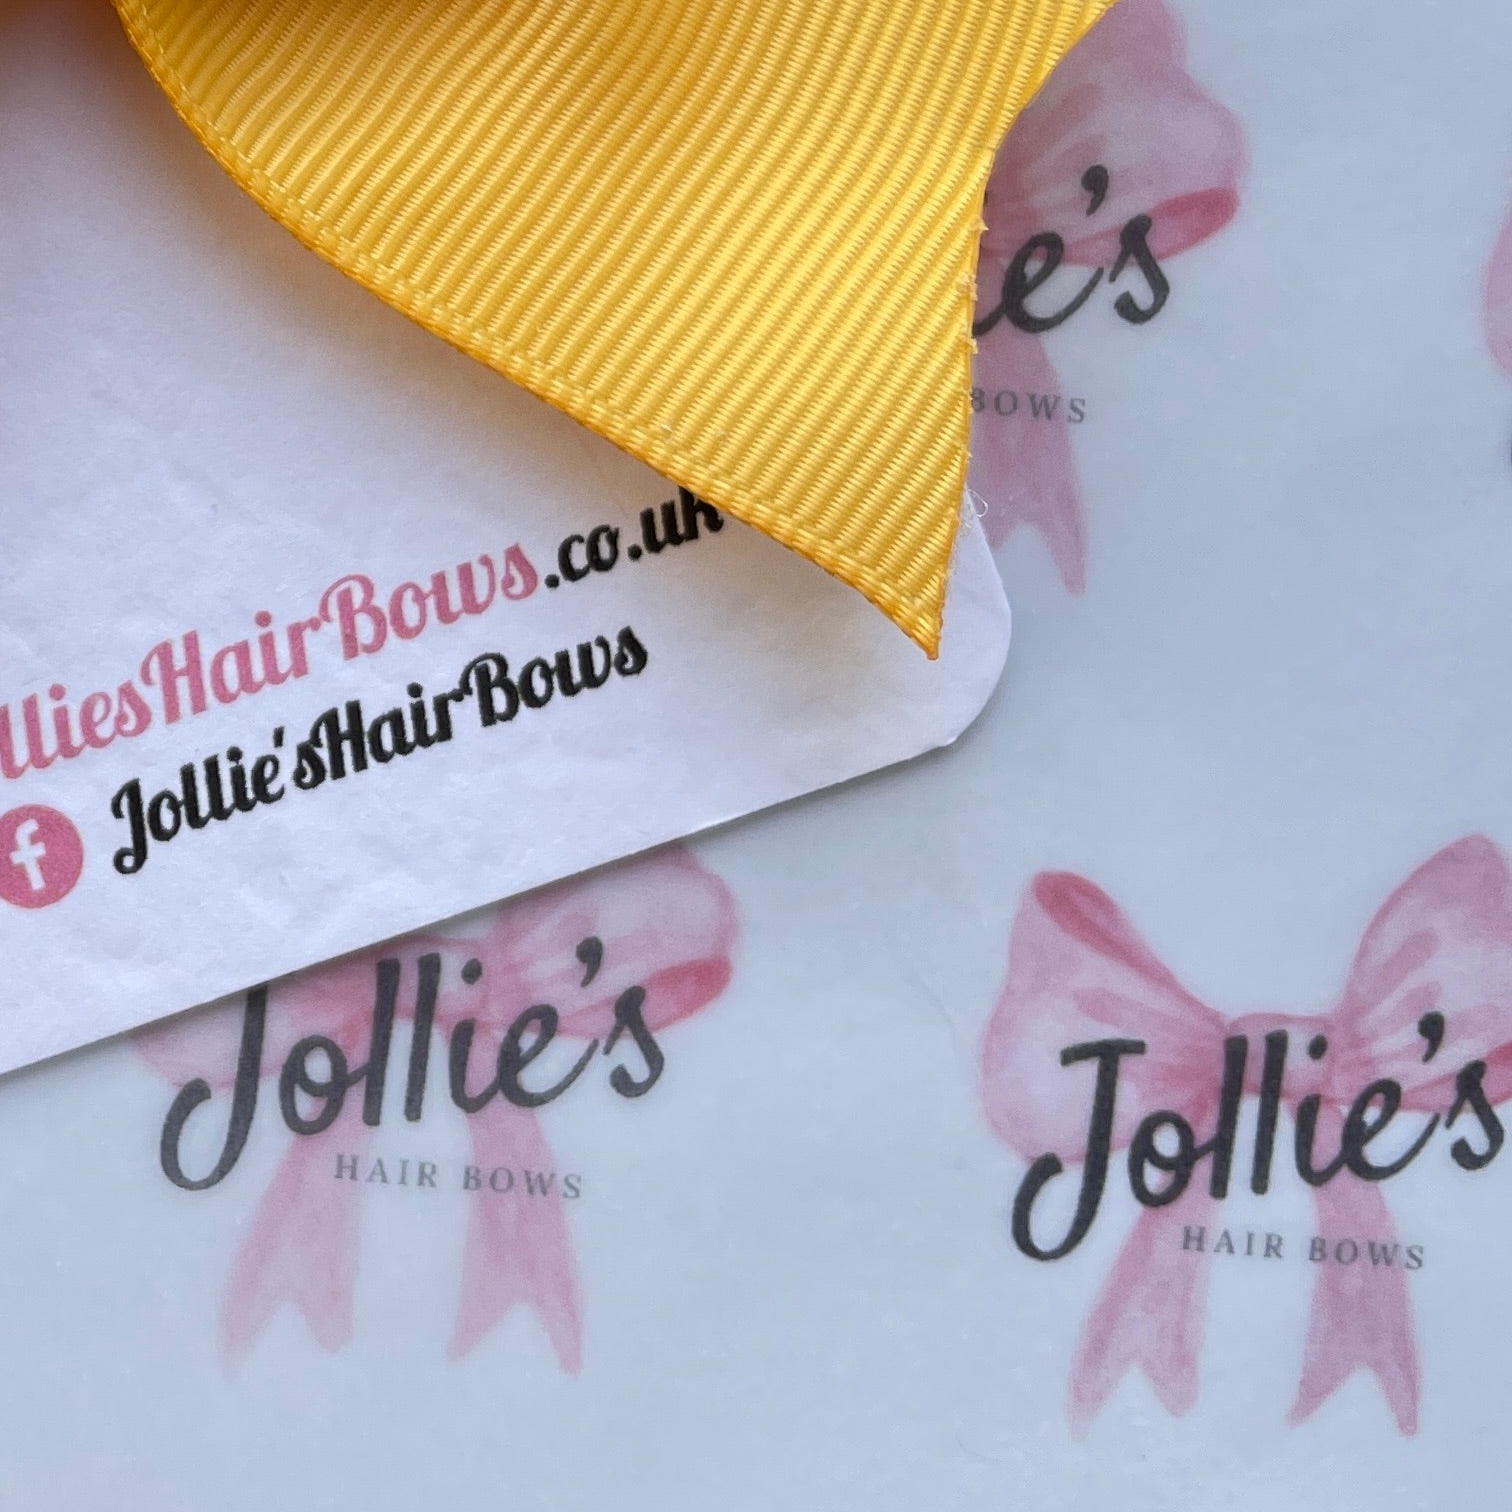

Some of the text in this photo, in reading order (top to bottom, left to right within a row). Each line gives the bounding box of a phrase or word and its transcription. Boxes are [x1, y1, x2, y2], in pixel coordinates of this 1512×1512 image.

[110, 626, 649, 875] Jollie'sHairBows
[160, 935, 664, 1190] Jollie's
[334, 1152, 583, 1199] HAIR BOWS
[1012, 1011, 1504, 1261] Jollie's
[1182, 1226, 1425, 1270] HAIR BOWS
